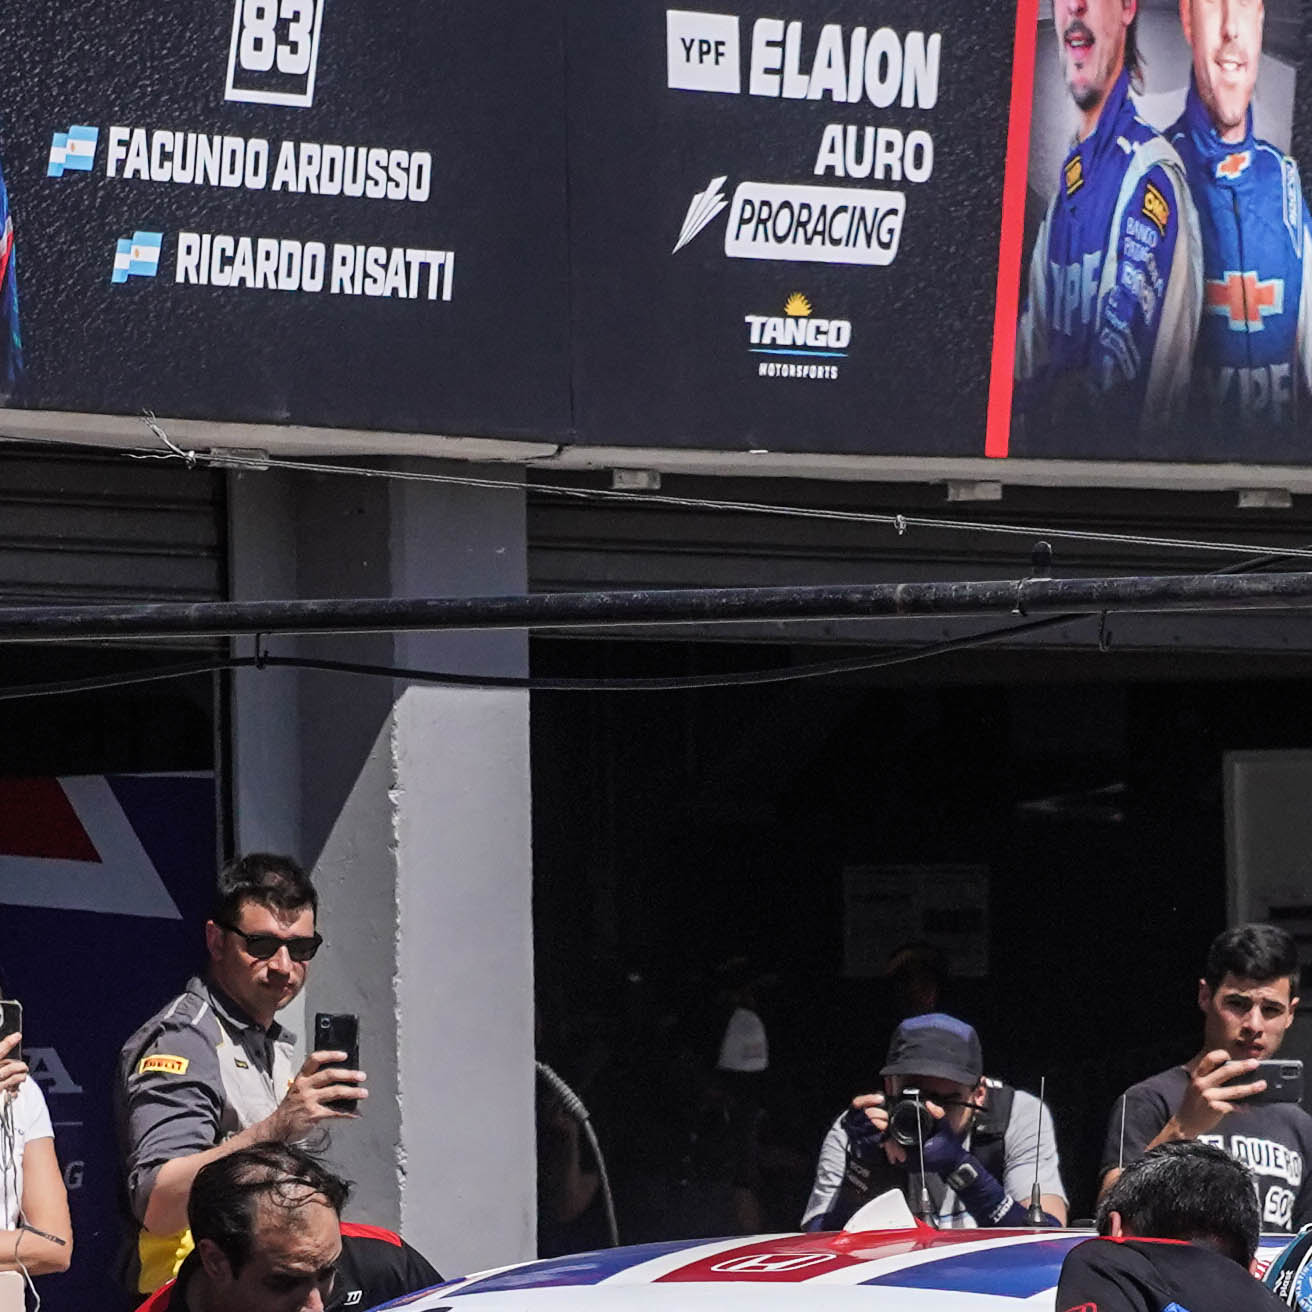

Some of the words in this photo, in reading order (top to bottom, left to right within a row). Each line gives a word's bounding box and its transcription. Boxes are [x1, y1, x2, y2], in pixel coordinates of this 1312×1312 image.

[239, 0, 314, 74] 83
[680, 37, 727, 67] YPF
[749, 18, 942, 109] ELAION
[106, 126, 269, 190] FACUNDO
[272, 141, 433, 202] ARDUSSO
[814, 124, 935, 183] AURO
[734, 198, 899, 251] PRORACING
[176, 231, 326, 293] RICARDO
[330, 244, 455, 301] RISATTI
[744, 315, 852, 348] TANGO
[758, 362, 839, 380] MOTORSPORTS
